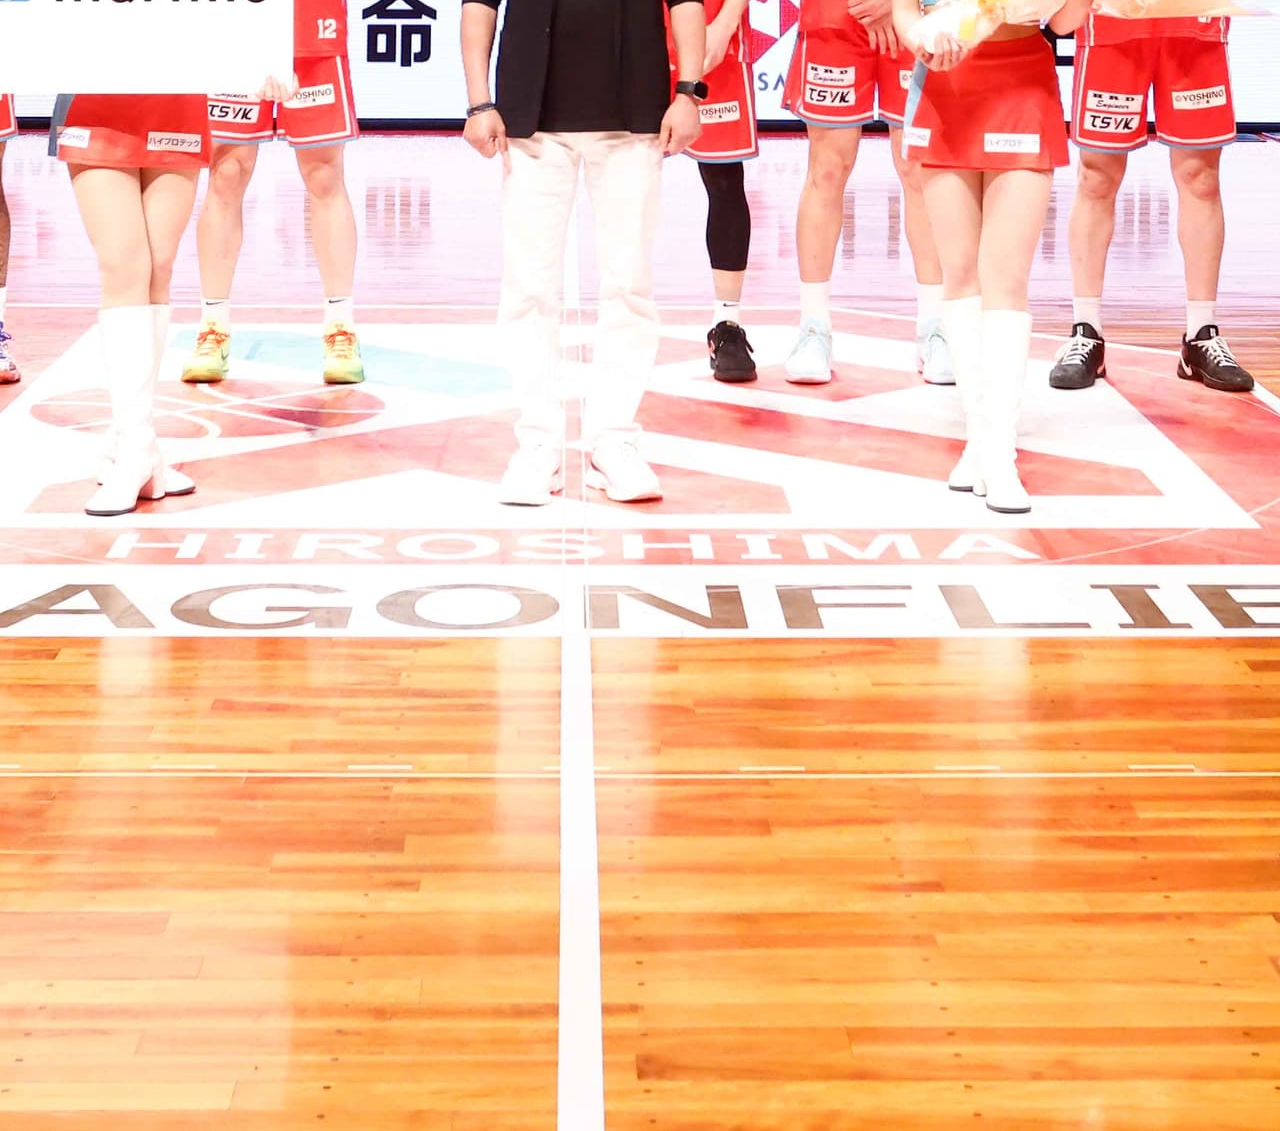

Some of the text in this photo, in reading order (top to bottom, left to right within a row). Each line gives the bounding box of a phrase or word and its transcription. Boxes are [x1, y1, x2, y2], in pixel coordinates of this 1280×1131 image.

[317, 19, 337, 38] 12
[293, 88, 332, 100] OSHINO
[1182, 89, 1224, 102] YOSHINO
[699, 105, 738, 116] OSHINO
[104, 532, 1042, 561] HIROSHIMA
